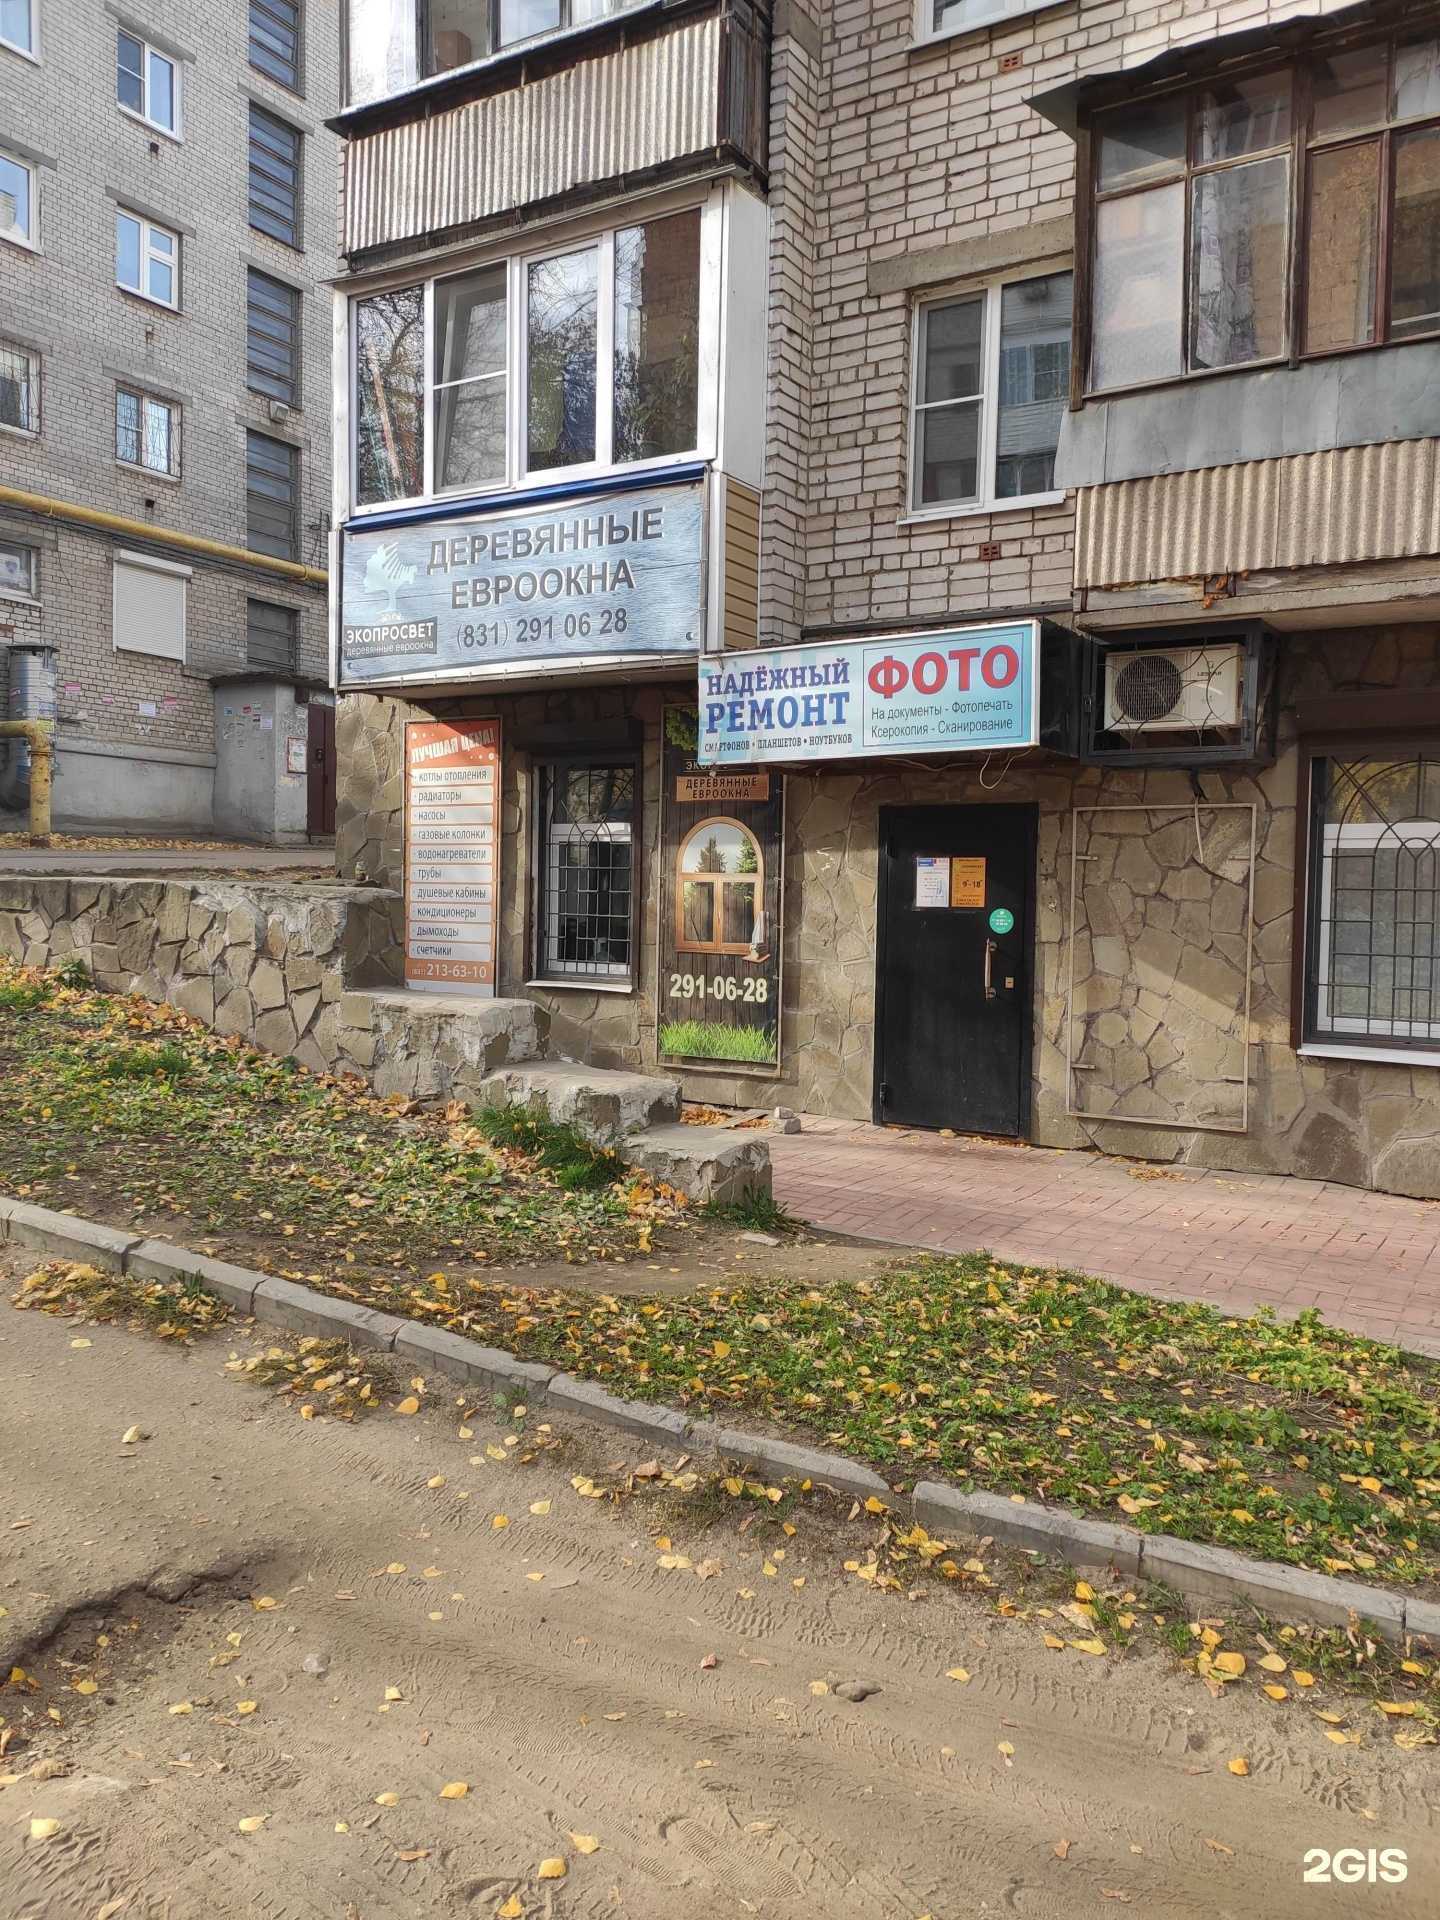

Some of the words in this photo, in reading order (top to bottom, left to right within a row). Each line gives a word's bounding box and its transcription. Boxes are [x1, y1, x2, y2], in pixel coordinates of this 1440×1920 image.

[427, 507, 665, 575] ДЕРЕВЯННЫЕ
[451, 559, 635, 609] ЕВРООКНА
[346, 622, 434, 644] ЭКОПРОСВЕТ
[456, 621, 509, 649] (831)
[516, 615, 554, 643] 291
[564, 611, 591, 638] 06
[600, 608, 628, 634] 28
[346, 642, 394, 656] деревянные
[396, 640, 434, 654] евроокна
[706, 657, 851, 697] НАДЁЖНЫЙ
[867, 644, 1019, 699] ФОТО
[705, 692, 850, 734] РЕМОНТ
[871, 708, 886, 721] На
[887, 705, 942, 721] документы
[951, 700, 1013, 716] Фотопечать
[871, 724, 929, 740] Ксерокопия
[937, 718, 1013, 736] Сканирование
[411, 736, 459, 763] ЛУЧШАЯ
[460, 728, 496, 752] ЦЕНА!
[757, 737, 802, 750] ПЛАНШЕТОВ
[809, 733, 853, 746] НОУТБУКОВ
[418, 772, 443, 783] котлы
[444, 770, 487, 782] отопления
[685, 777, 758, 790] ДЕРЕВЯННЫЕ
[418, 789, 462, 803] радиаторы
[692, 788, 750, 799] ЕВРООКНА
[418, 810, 446, 821] насосы
[418, 829, 450, 840] газовые
[452, 828, 486, 839] колонки
[418, 847, 486, 860] водонагреватели
[417, 867, 442, 881] трубы
[417, 887, 454, 901] душевые
[455, 886, 487, 899] кабины
[417, 906, 477, 919] кондиционеры
[416, 926, 459, 939] дымоходы
[416, 945, 452, 956] счетчики
[426, 963, 487, 979] 213-63-10
[670, 974, 768, 1004] 291-06-28
